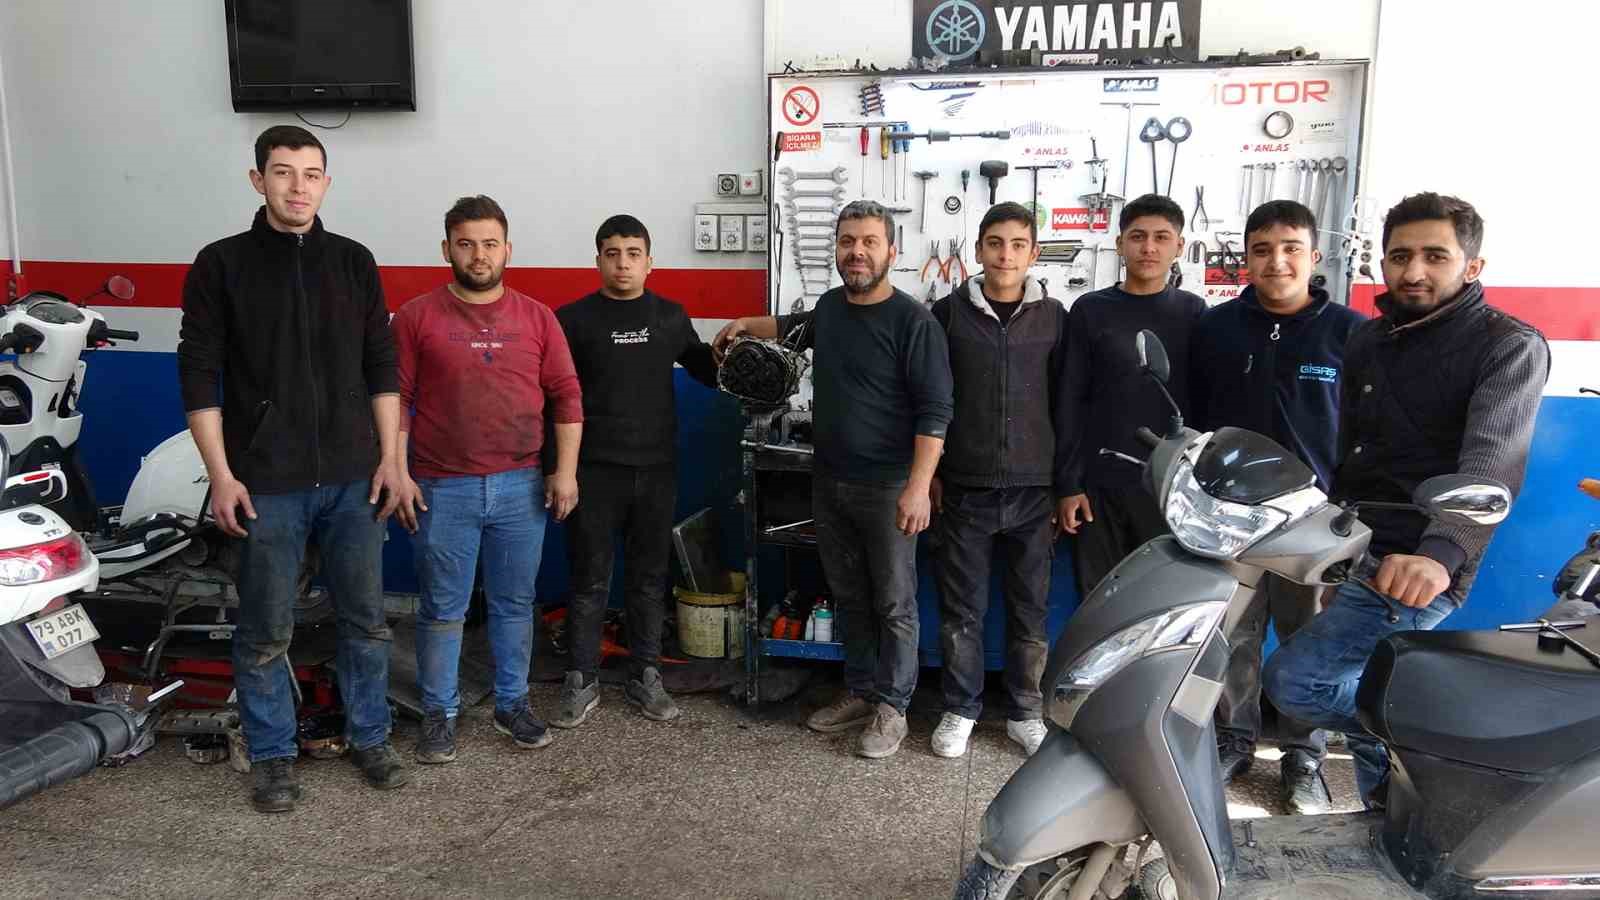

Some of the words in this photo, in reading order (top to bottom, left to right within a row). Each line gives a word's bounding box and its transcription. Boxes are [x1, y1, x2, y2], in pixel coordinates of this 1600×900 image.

[994, 2, 1183, 51] YAMAHA
[1213, 80, 1330, 104] OTOR
[34, 621, 55, 639] 79
[58, 608, 85, 630] ABK
[57, 628, 83, 648] 077
